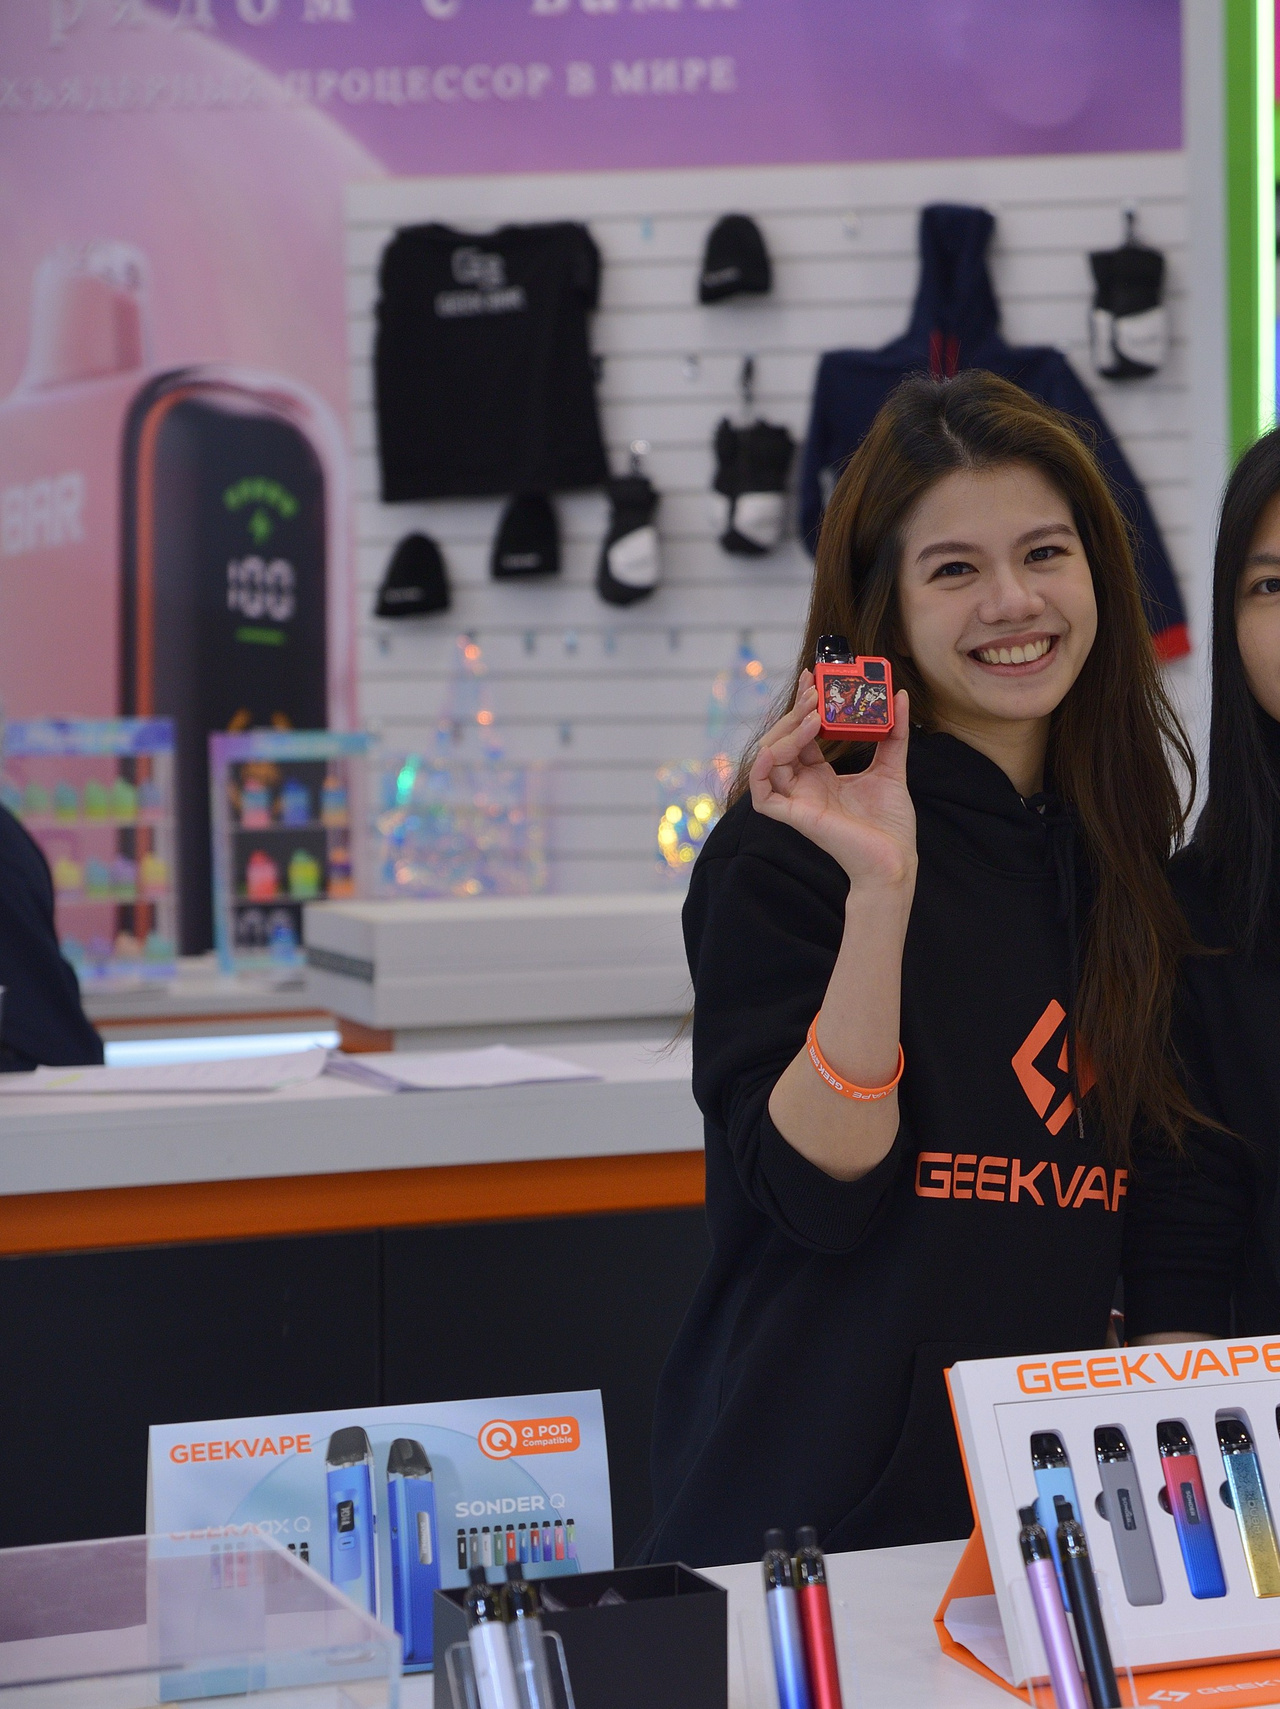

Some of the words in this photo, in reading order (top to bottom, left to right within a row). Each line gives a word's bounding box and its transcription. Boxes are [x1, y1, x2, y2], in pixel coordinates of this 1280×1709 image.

[566, 60, 595, 98] В
[611, 55, 736, 96] МИРЕ
[915, 1151, 1129, 1212] GEEKVAP
[521, 1426, 533, 1438] Q
[538, 1423, 571, 1437] POD
[522, 1436, 572, 1447] Compatible
[169, 1434, 312, 1464] GEEKVAPE
[455, 1495, 545, 1518] SONDER
[549, 1493, 566, 1509] Q
[1185, 1490, 1196, 1517] SONDER
[293, 1516, 311, 1533] Q
